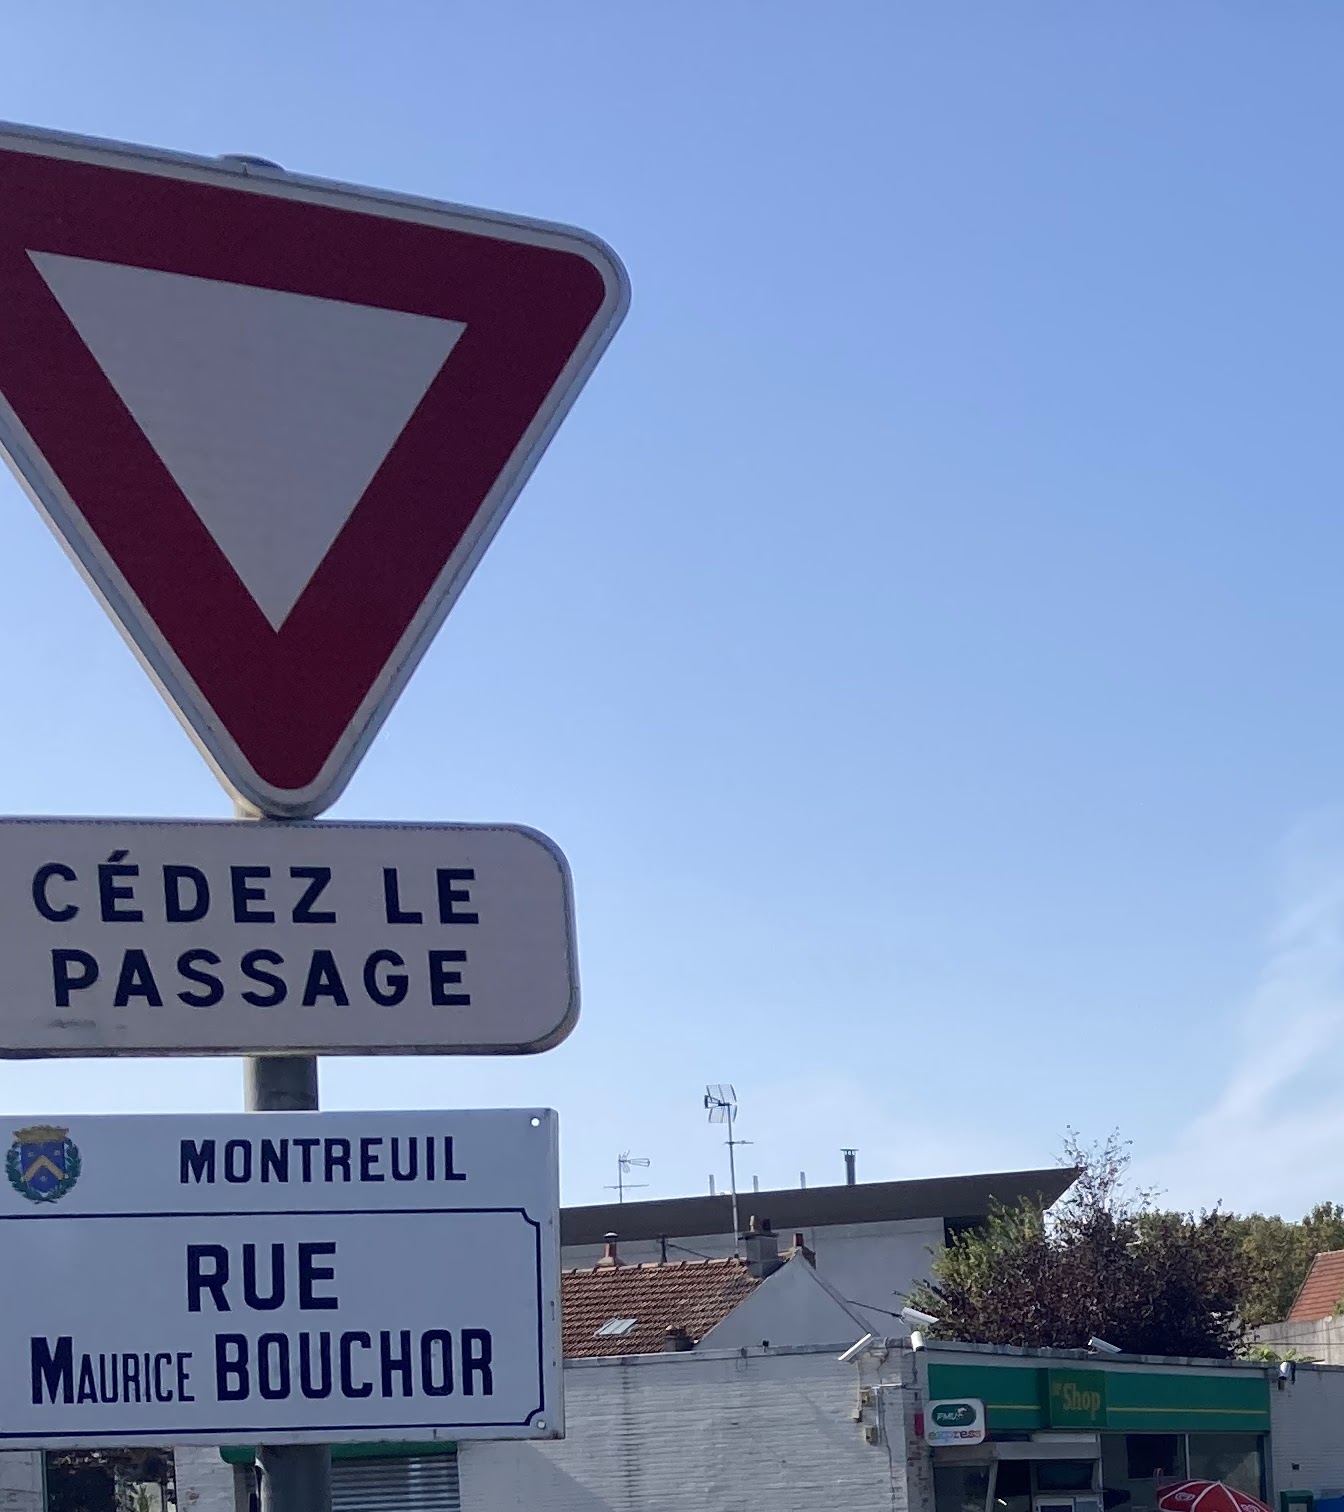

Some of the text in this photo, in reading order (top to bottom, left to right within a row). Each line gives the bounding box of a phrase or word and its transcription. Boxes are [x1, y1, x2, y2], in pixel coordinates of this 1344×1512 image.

[32, 849, 480, 925] CÉDEZ LE
[51, 948, 472, 1008] PASSAGE
[179, 1136, 467, 1185] MONTREUIL
[185, 1241, 340, 1313] RUE
[214, 1328, 494, 1402] BOUCHOR
[1062, 1382, 1101, 1421] Shop
